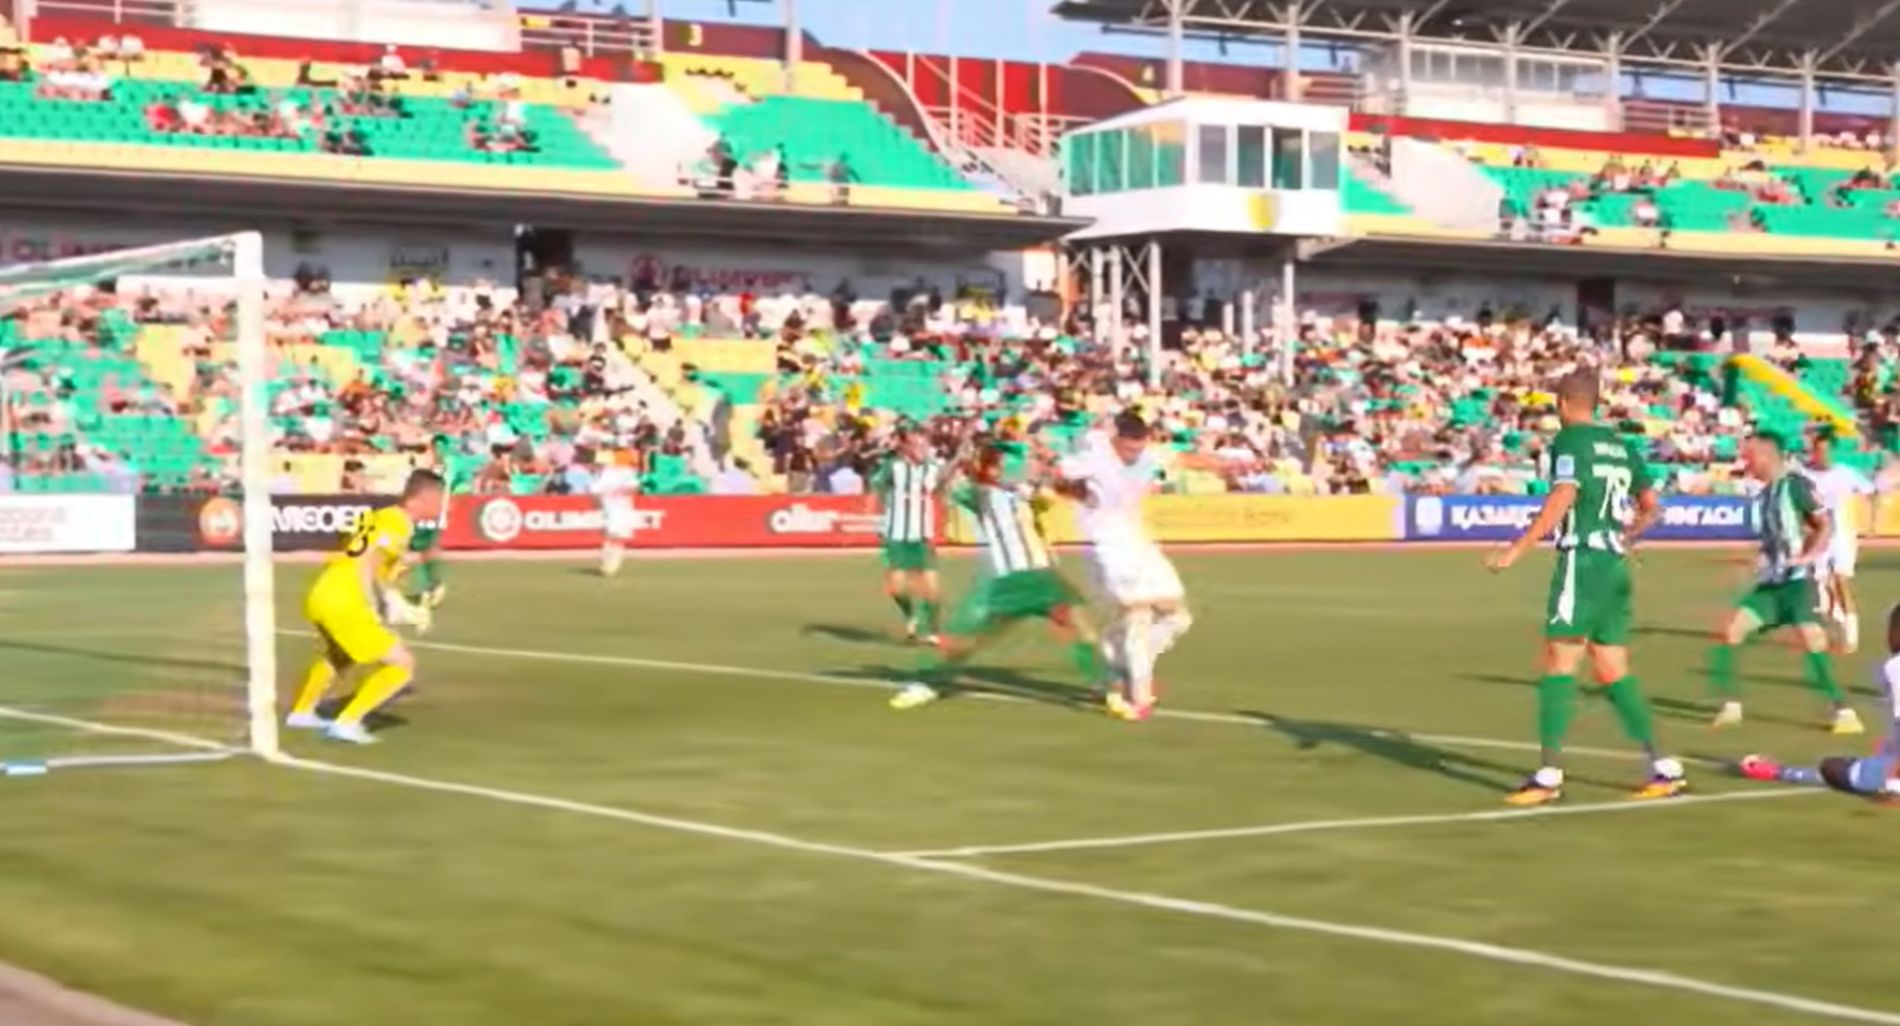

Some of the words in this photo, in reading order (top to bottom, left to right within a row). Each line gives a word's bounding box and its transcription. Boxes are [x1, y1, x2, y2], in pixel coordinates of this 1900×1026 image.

[1592, 464, 1632, 522] 78
[525, 510, 666, 532] OLIMET
[1451, 504, 1542, 530] ҚАЗАҚС
